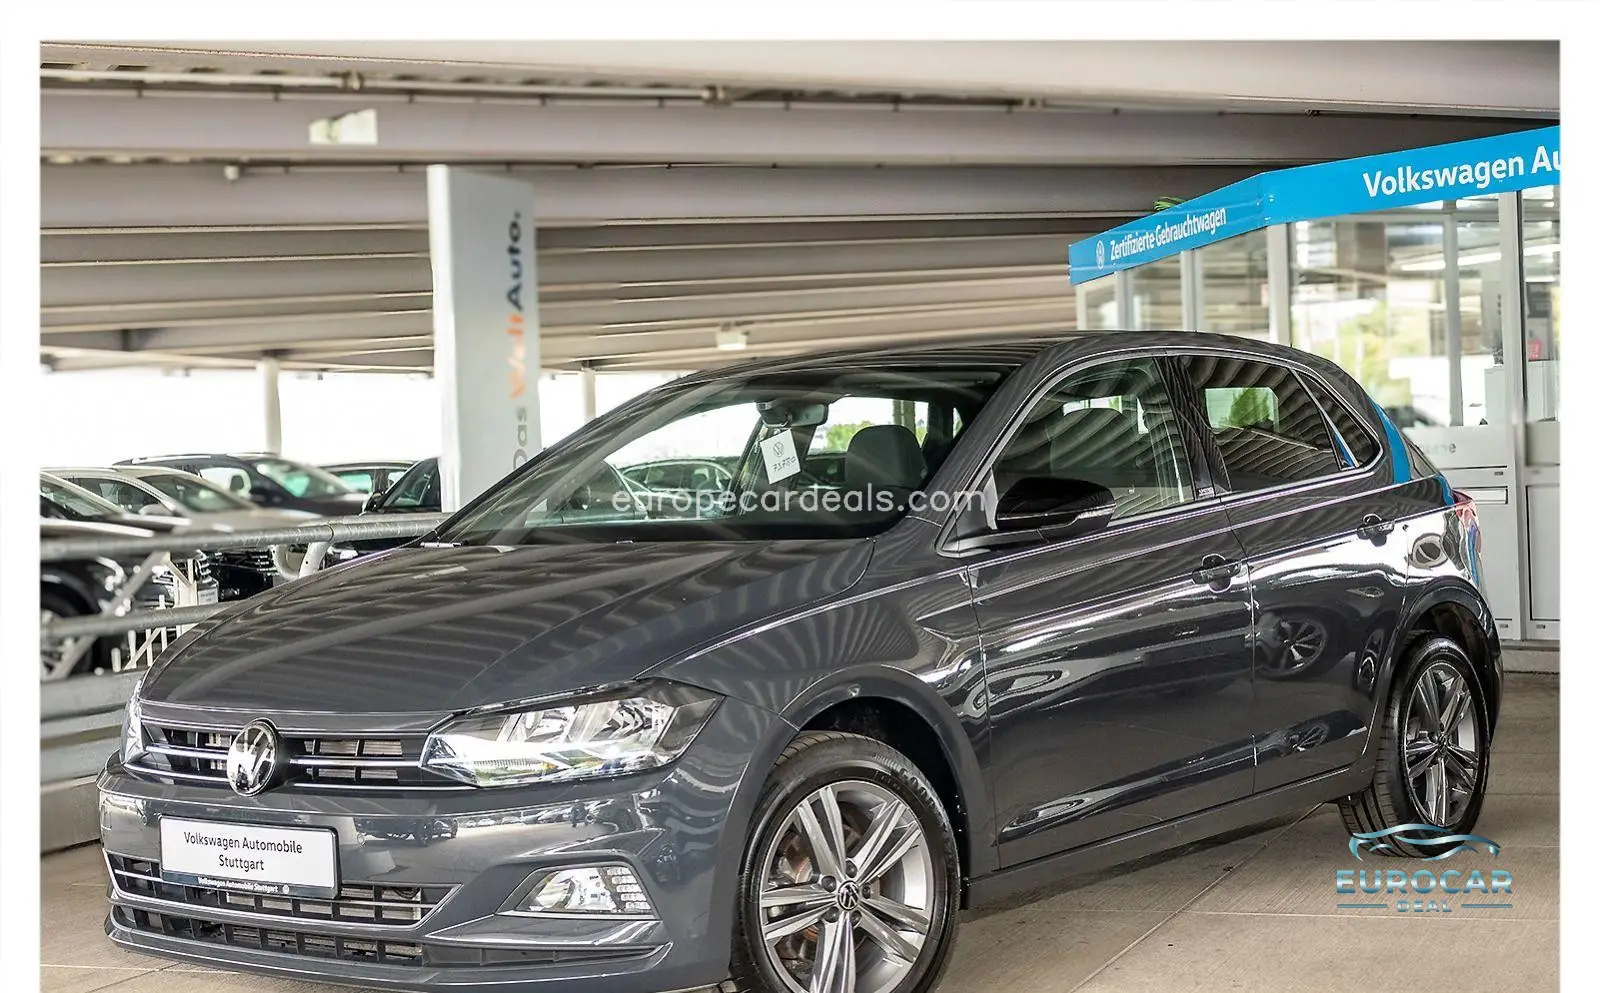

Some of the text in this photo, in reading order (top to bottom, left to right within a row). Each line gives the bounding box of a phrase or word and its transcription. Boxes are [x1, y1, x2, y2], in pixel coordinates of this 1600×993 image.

[1362, 155, 1524, 198] Volkswagen
[1110, 207, 1227, 261] Zertifizierte Gebrauchtwagen
[184, 831, 303, 854] Volkswagen Automobile
[218, 854, 265, 873] Stuttgart
[197, 876, 226, 888] Volkswagen
